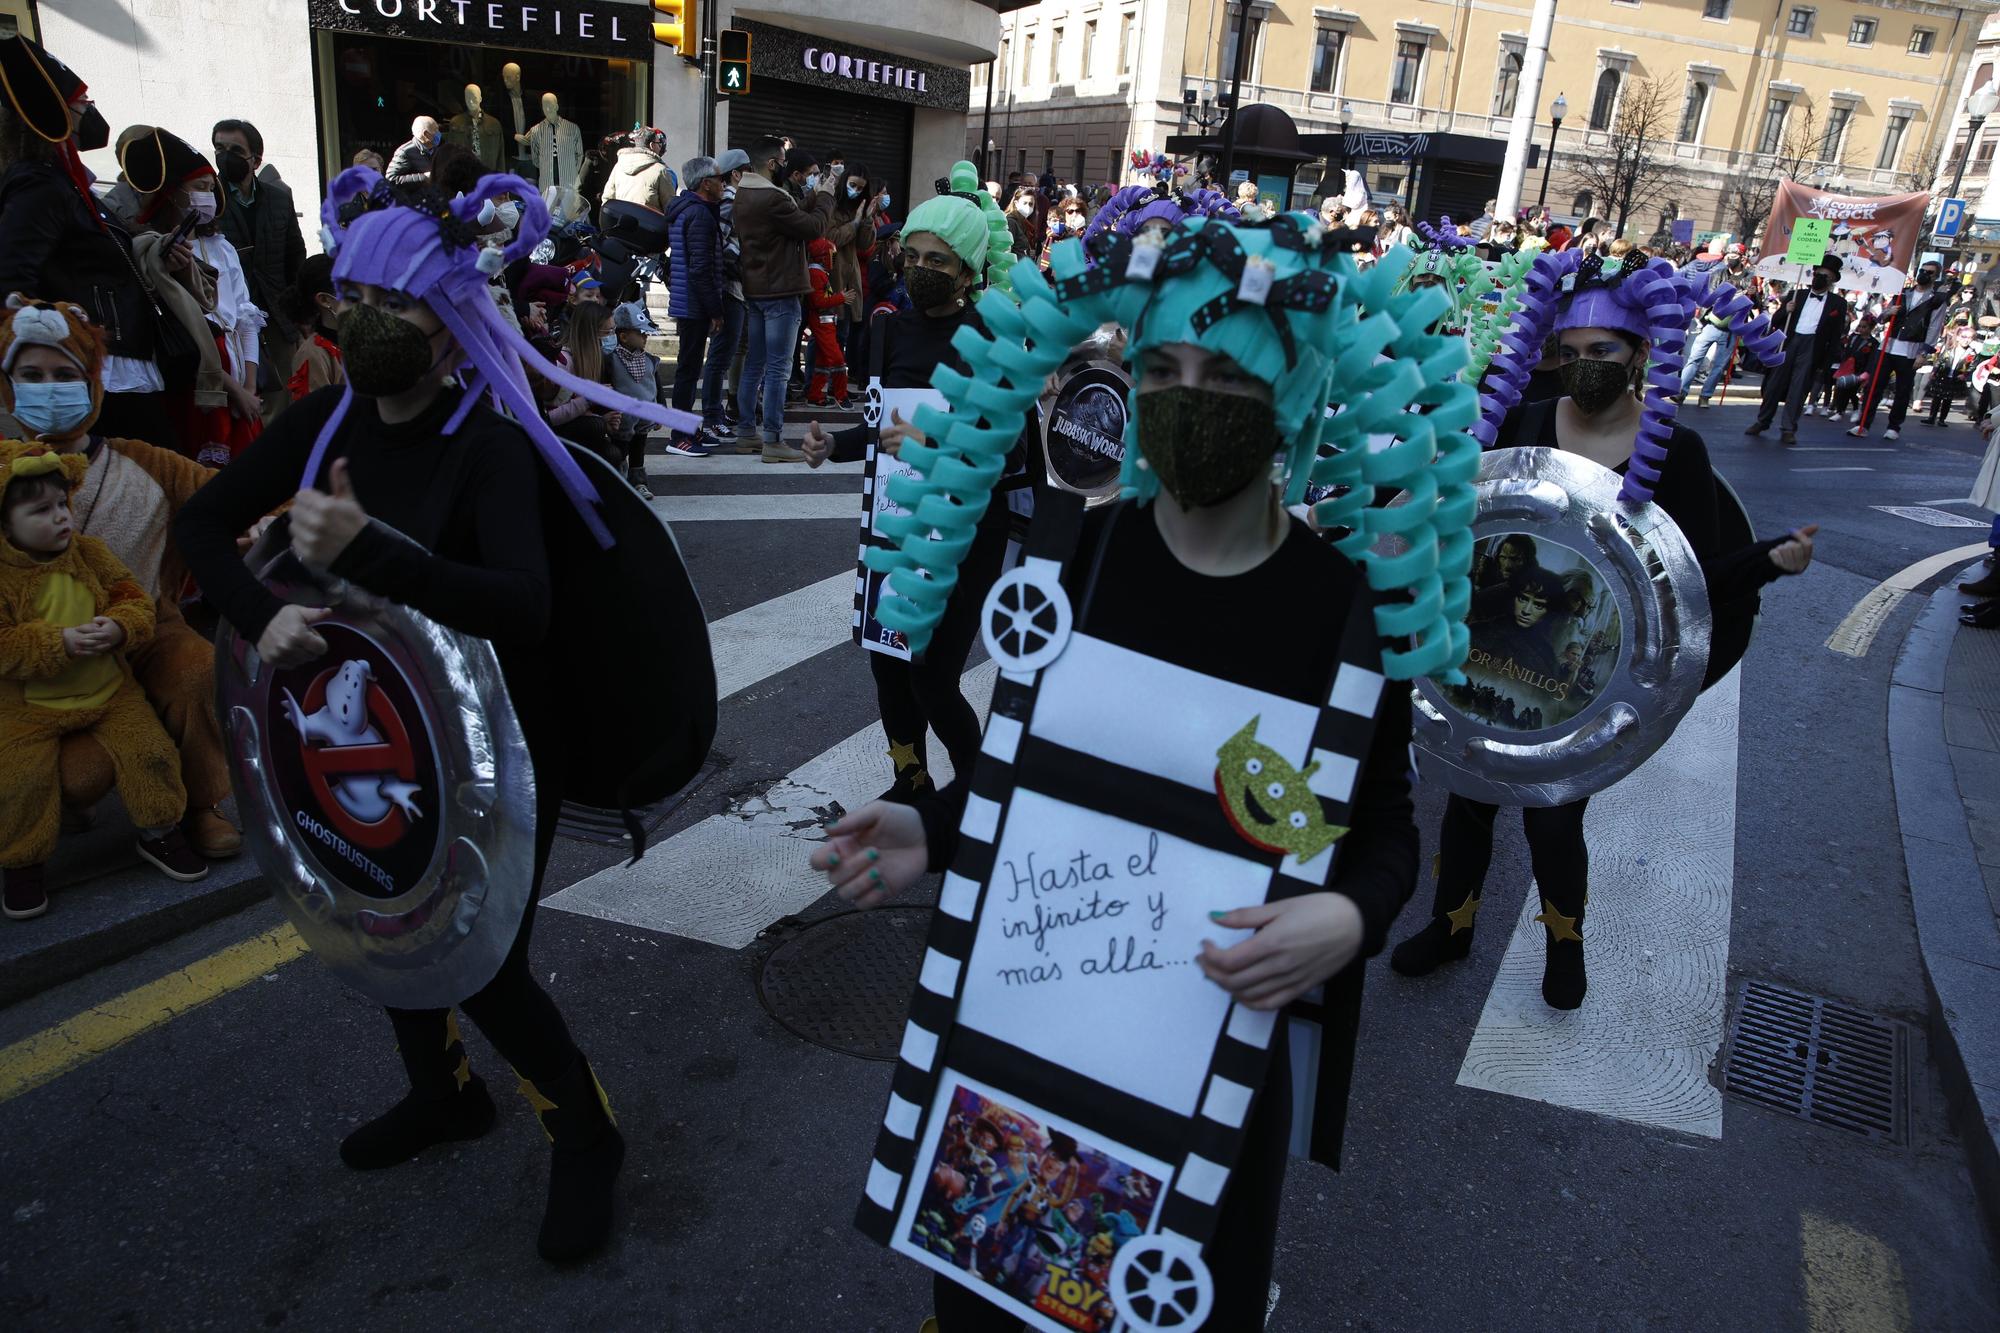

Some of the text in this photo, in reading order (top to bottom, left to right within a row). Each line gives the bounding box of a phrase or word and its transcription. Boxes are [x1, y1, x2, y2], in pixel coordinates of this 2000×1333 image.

[803, 47, 928, 93] CORTEFIEL
[1826, 208, 1877, 220] ROCK
[1831, 201, 1878, 210] CODEMA
[1940, 203, 1960, 232] P
[1052, 415, 1093, 446] JURASSIC
[1089, 431, 1127, 462] WORLD
[1498, 657, 1569, 702] ANILLOS
[296, 810, 395, 892] GHOSTBUSTERS
[1003, 831, 1159, 902] Hasta el
[1001, 890, 1168, 952] infinito y
[996, 952, 1063, 986] más
[1040, 1294, 1089, 1325] STORY
[1045, 1263, 1105, 1312] TOY
